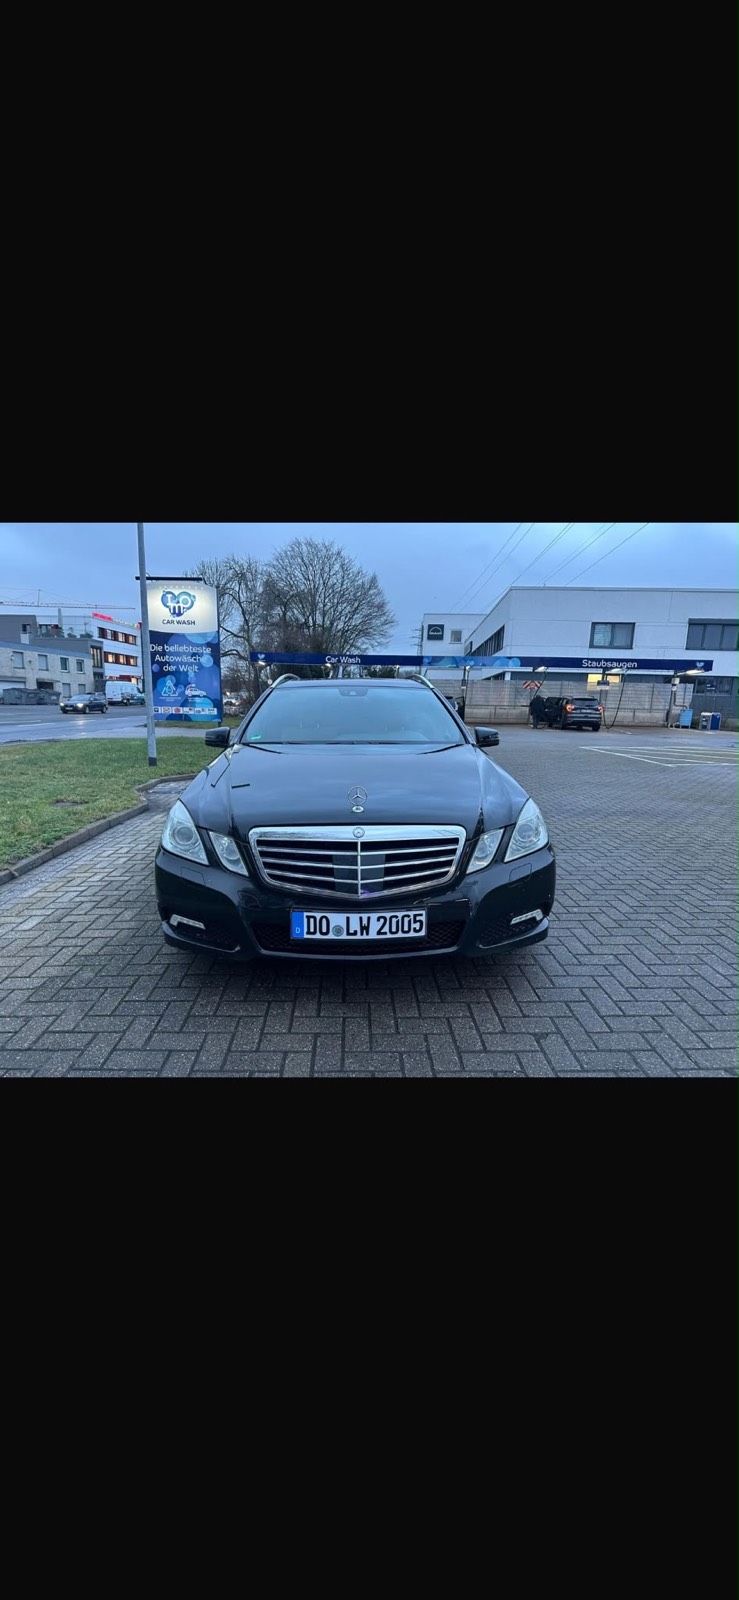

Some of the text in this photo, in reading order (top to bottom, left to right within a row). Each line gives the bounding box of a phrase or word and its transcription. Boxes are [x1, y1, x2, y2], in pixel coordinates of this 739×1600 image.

[150, 644, 212, 654] Die beliebteste
[155, 654, 206, 663] Autowäsch
[325, 655, 361, 664] Car Wash
[163, 664, 199, 673] der Welt
[582, 659, 638, 669] Staubsaugen
[305, 913, 424, 936] DO LW 2005
